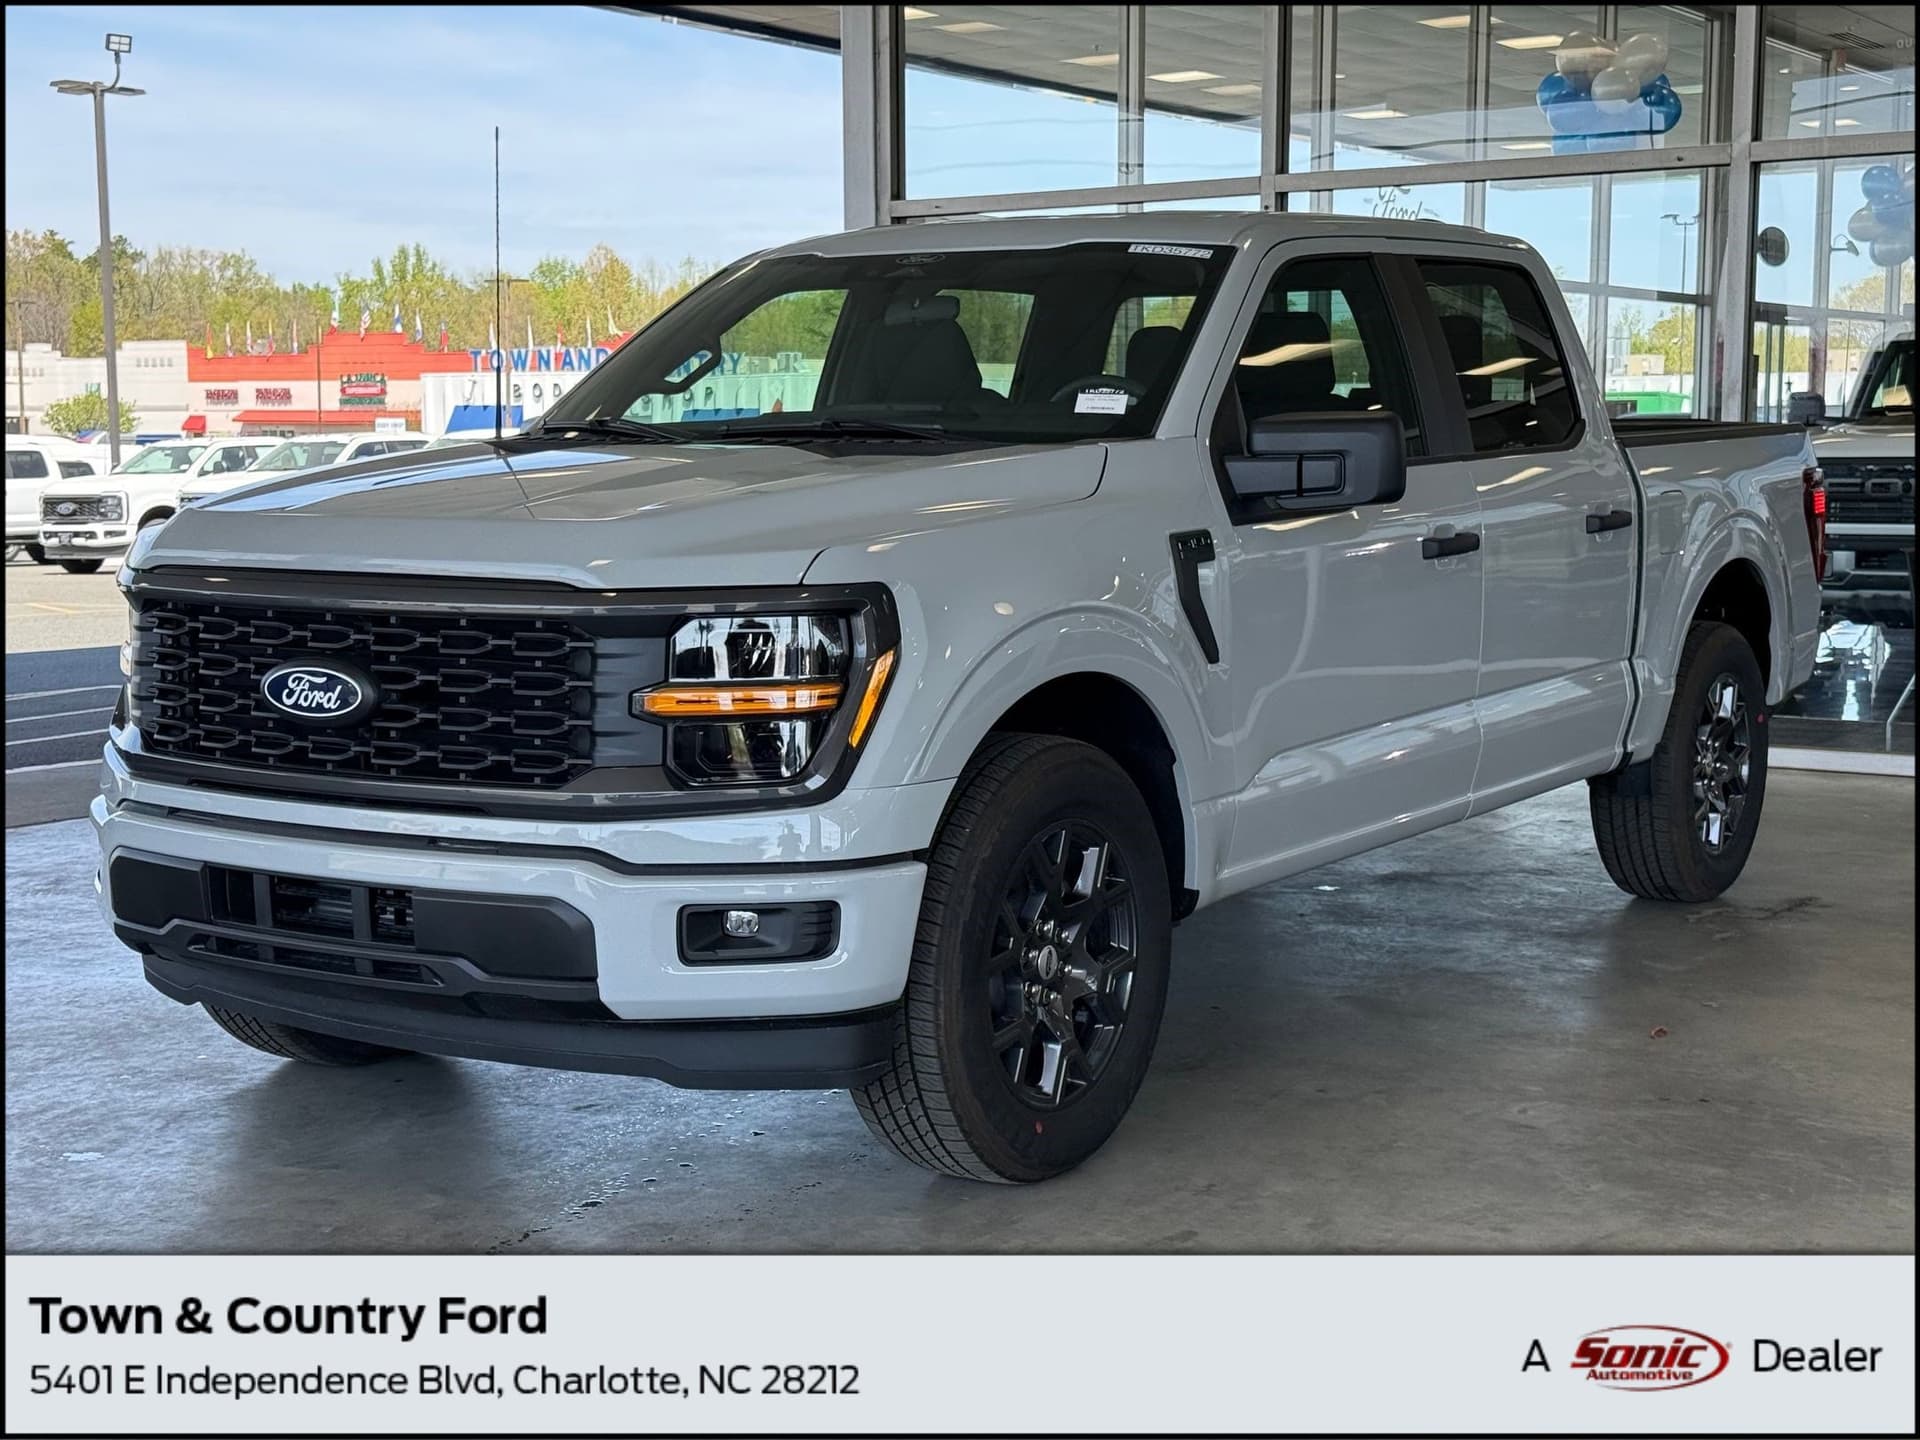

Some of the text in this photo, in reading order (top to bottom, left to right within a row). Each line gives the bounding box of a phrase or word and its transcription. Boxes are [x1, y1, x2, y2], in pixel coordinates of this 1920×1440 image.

[470, 349, 549, 371] TOWN
[513, 383, 563, 399] BOD
[282, 673, 342, 709] Ford
